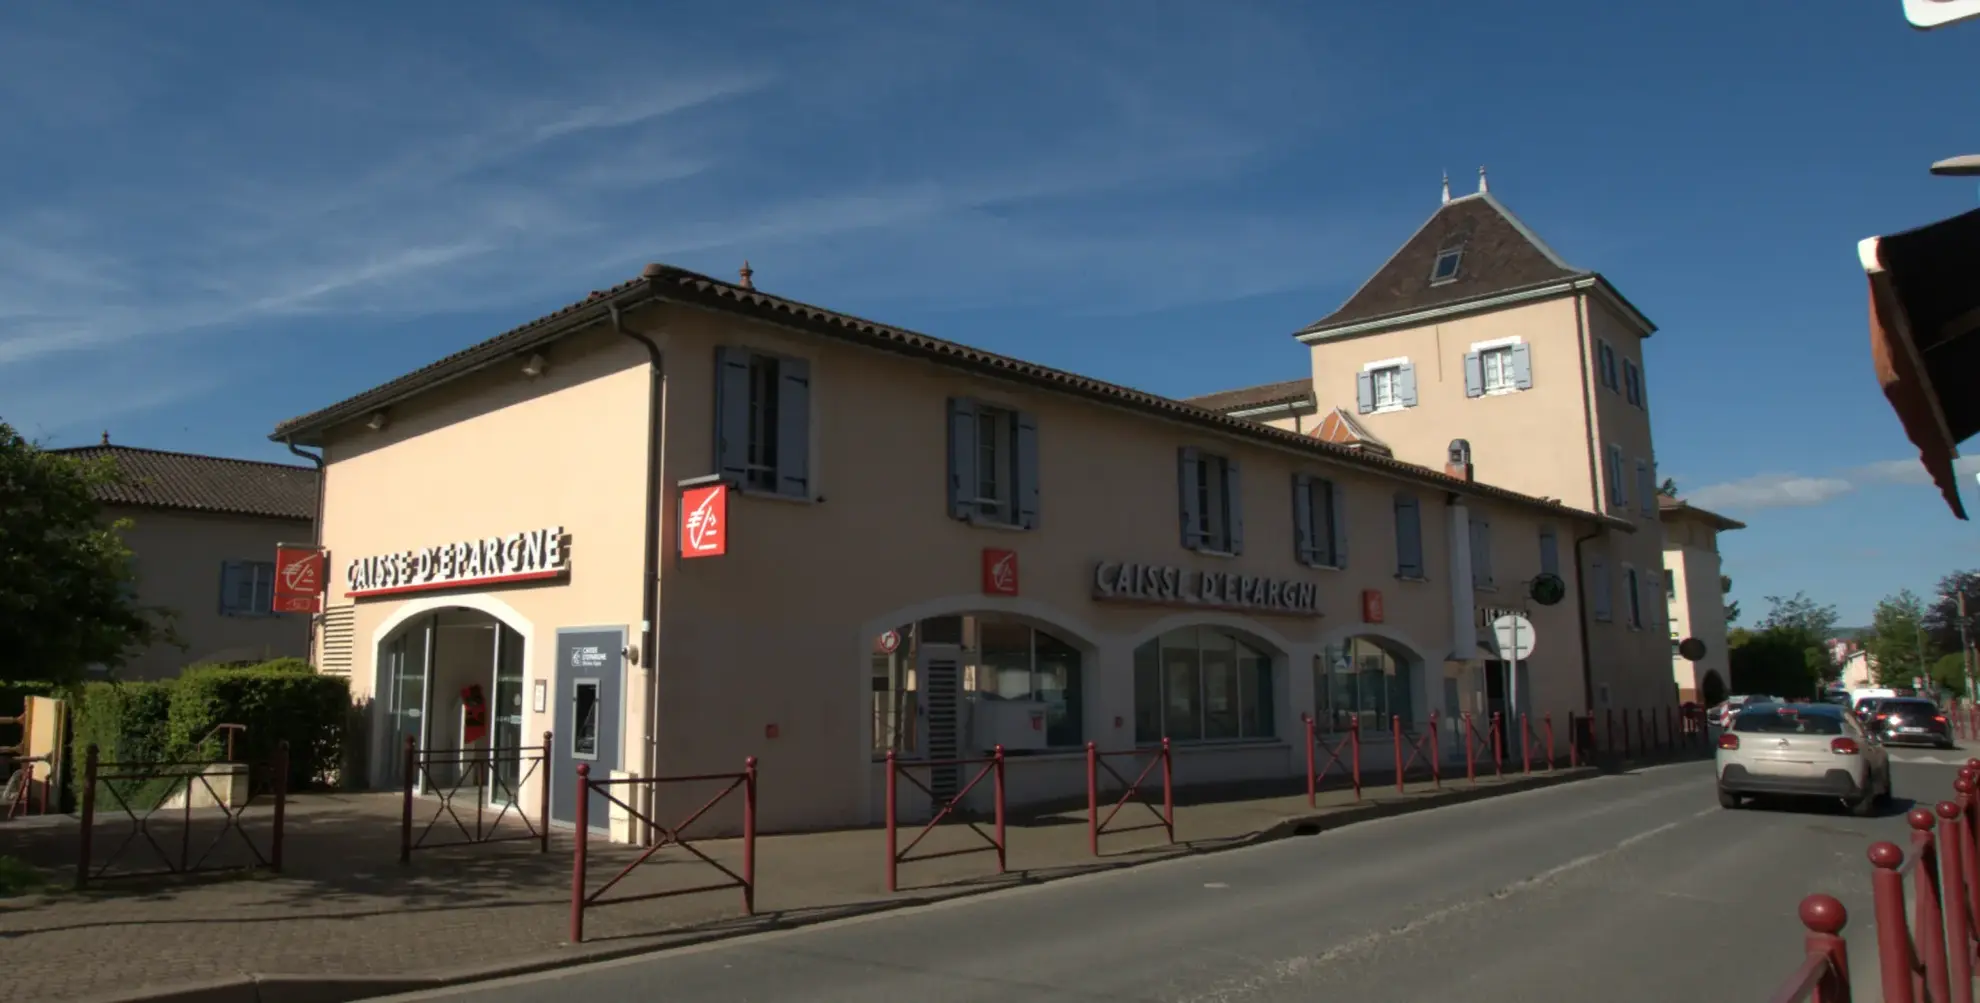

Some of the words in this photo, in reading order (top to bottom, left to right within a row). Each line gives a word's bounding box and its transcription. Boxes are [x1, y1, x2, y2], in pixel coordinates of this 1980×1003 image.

[347, 551, 413, 590] CAISSE
[419, 526, 563, 581] D'EPARGNE
[1201, 571, 1316, 612] D'EPARGN
